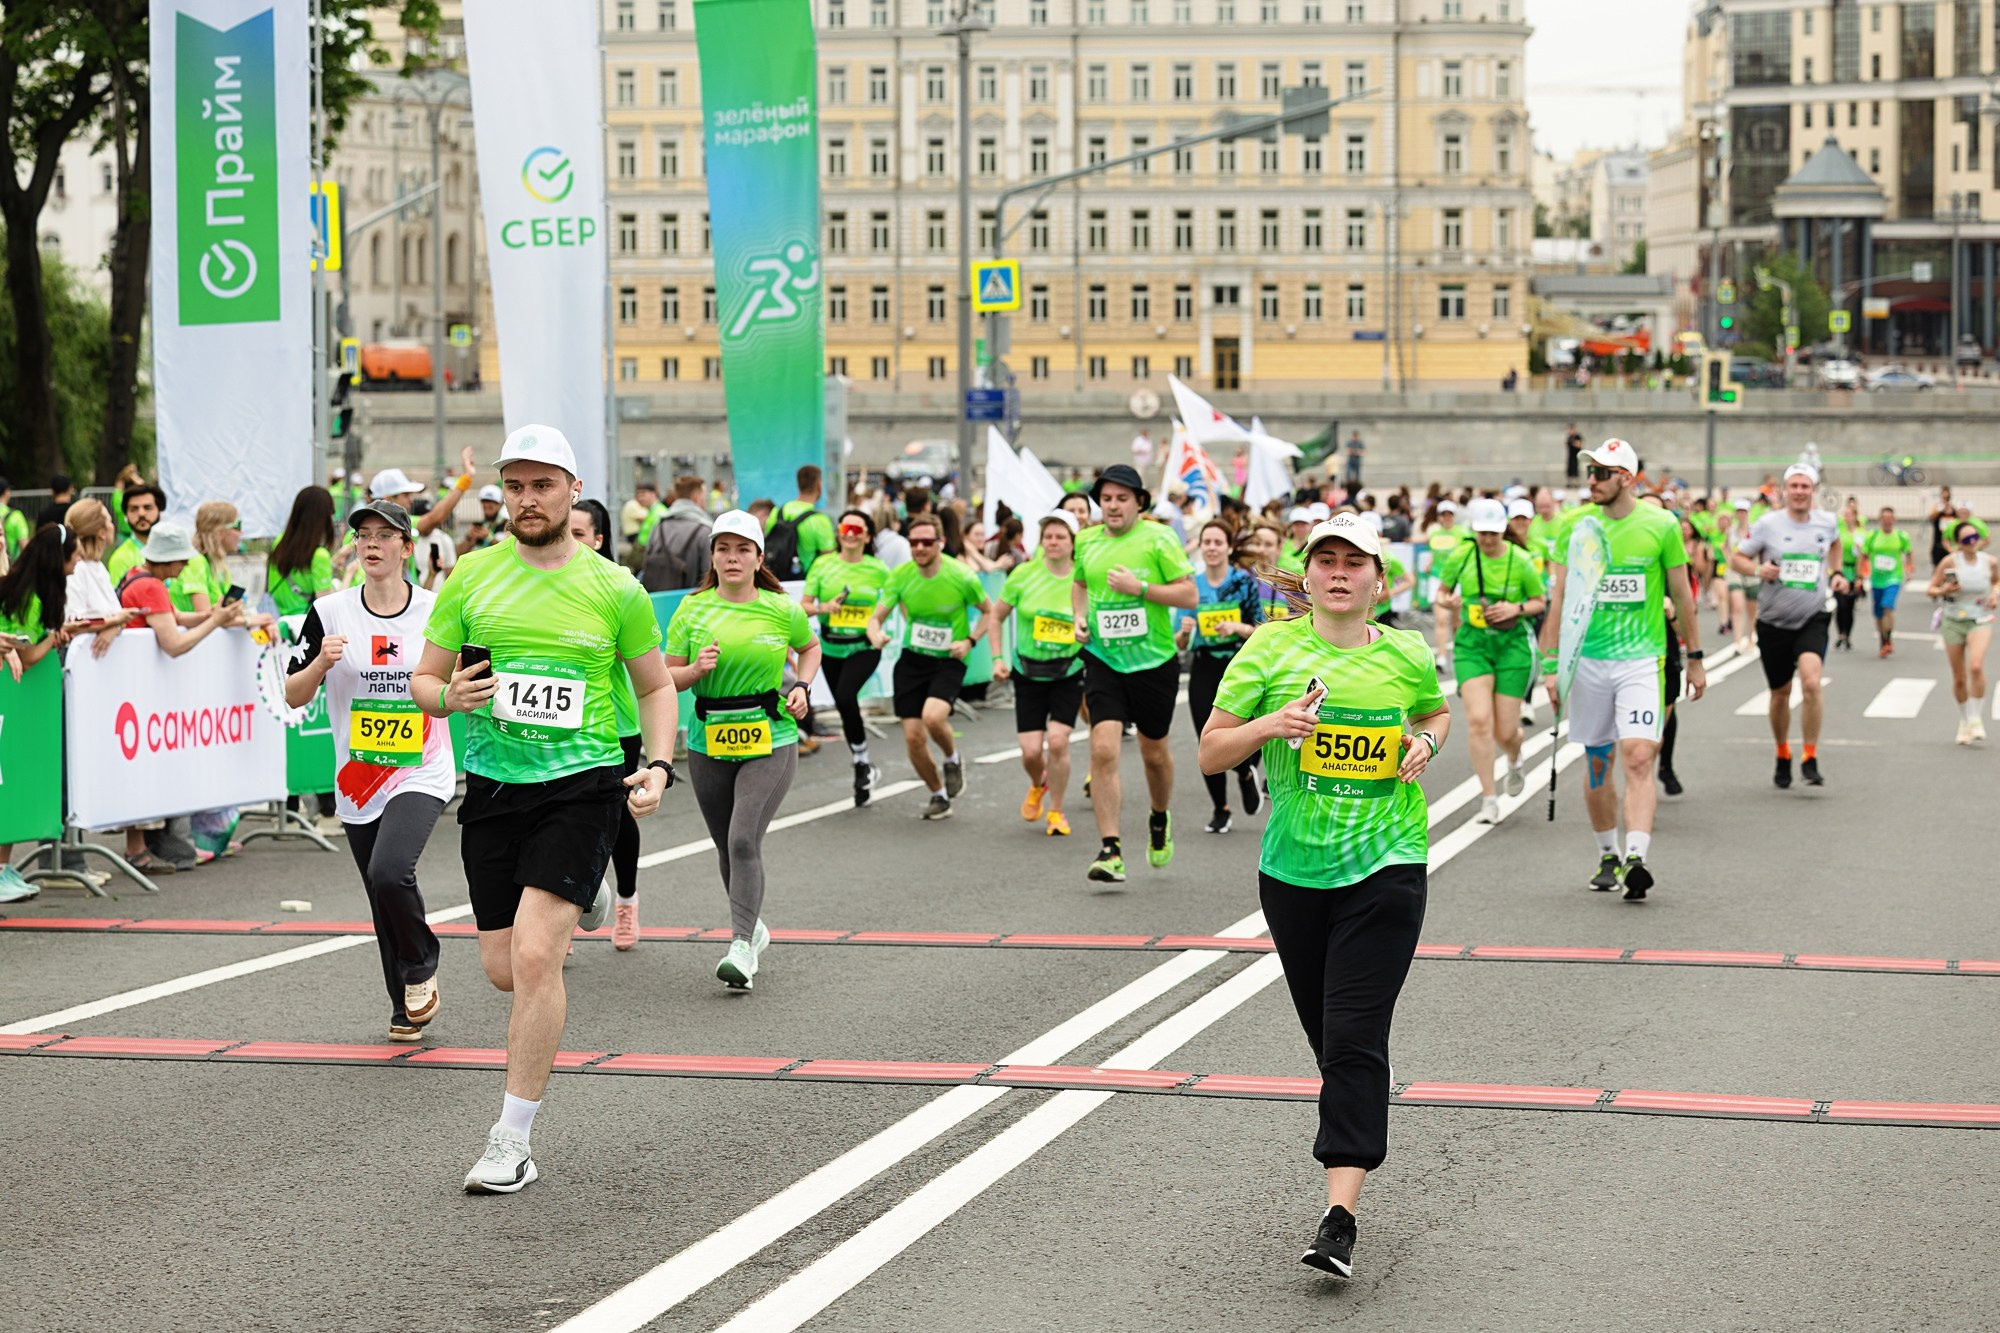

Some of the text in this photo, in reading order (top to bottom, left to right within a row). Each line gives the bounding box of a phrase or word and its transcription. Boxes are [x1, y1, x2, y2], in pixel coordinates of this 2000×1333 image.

[713, 95, 810, 127] зелёный
[202, 55, 255, 226] Прайм
[714, 120, 810, 148] марафон
[501, 216, 596, 249] СБЕР
[1599, 579, 1638, 593] 5653
[1103, 613, 1139, 629] 3278
[360, 671, 414, 681] четыре
[368, 683, 407, 693] лапы
[508, 681, 572, 711] 1415
[516, 709, 558, 721] ВАСИЛИЙ
[1629, 710, 1654, 725] 10
[147, 704, 255, 752] самокат
[360, 717, 413, 739] 5976
[500, 720, 509, 733] E
[715, 728, 762, 744] 4009
[1314, 731, 1387, 762] 5504
[1321, 761, 1378, 773] АНАСТАСИЯ
[1306, 775, 1318, 791] E
